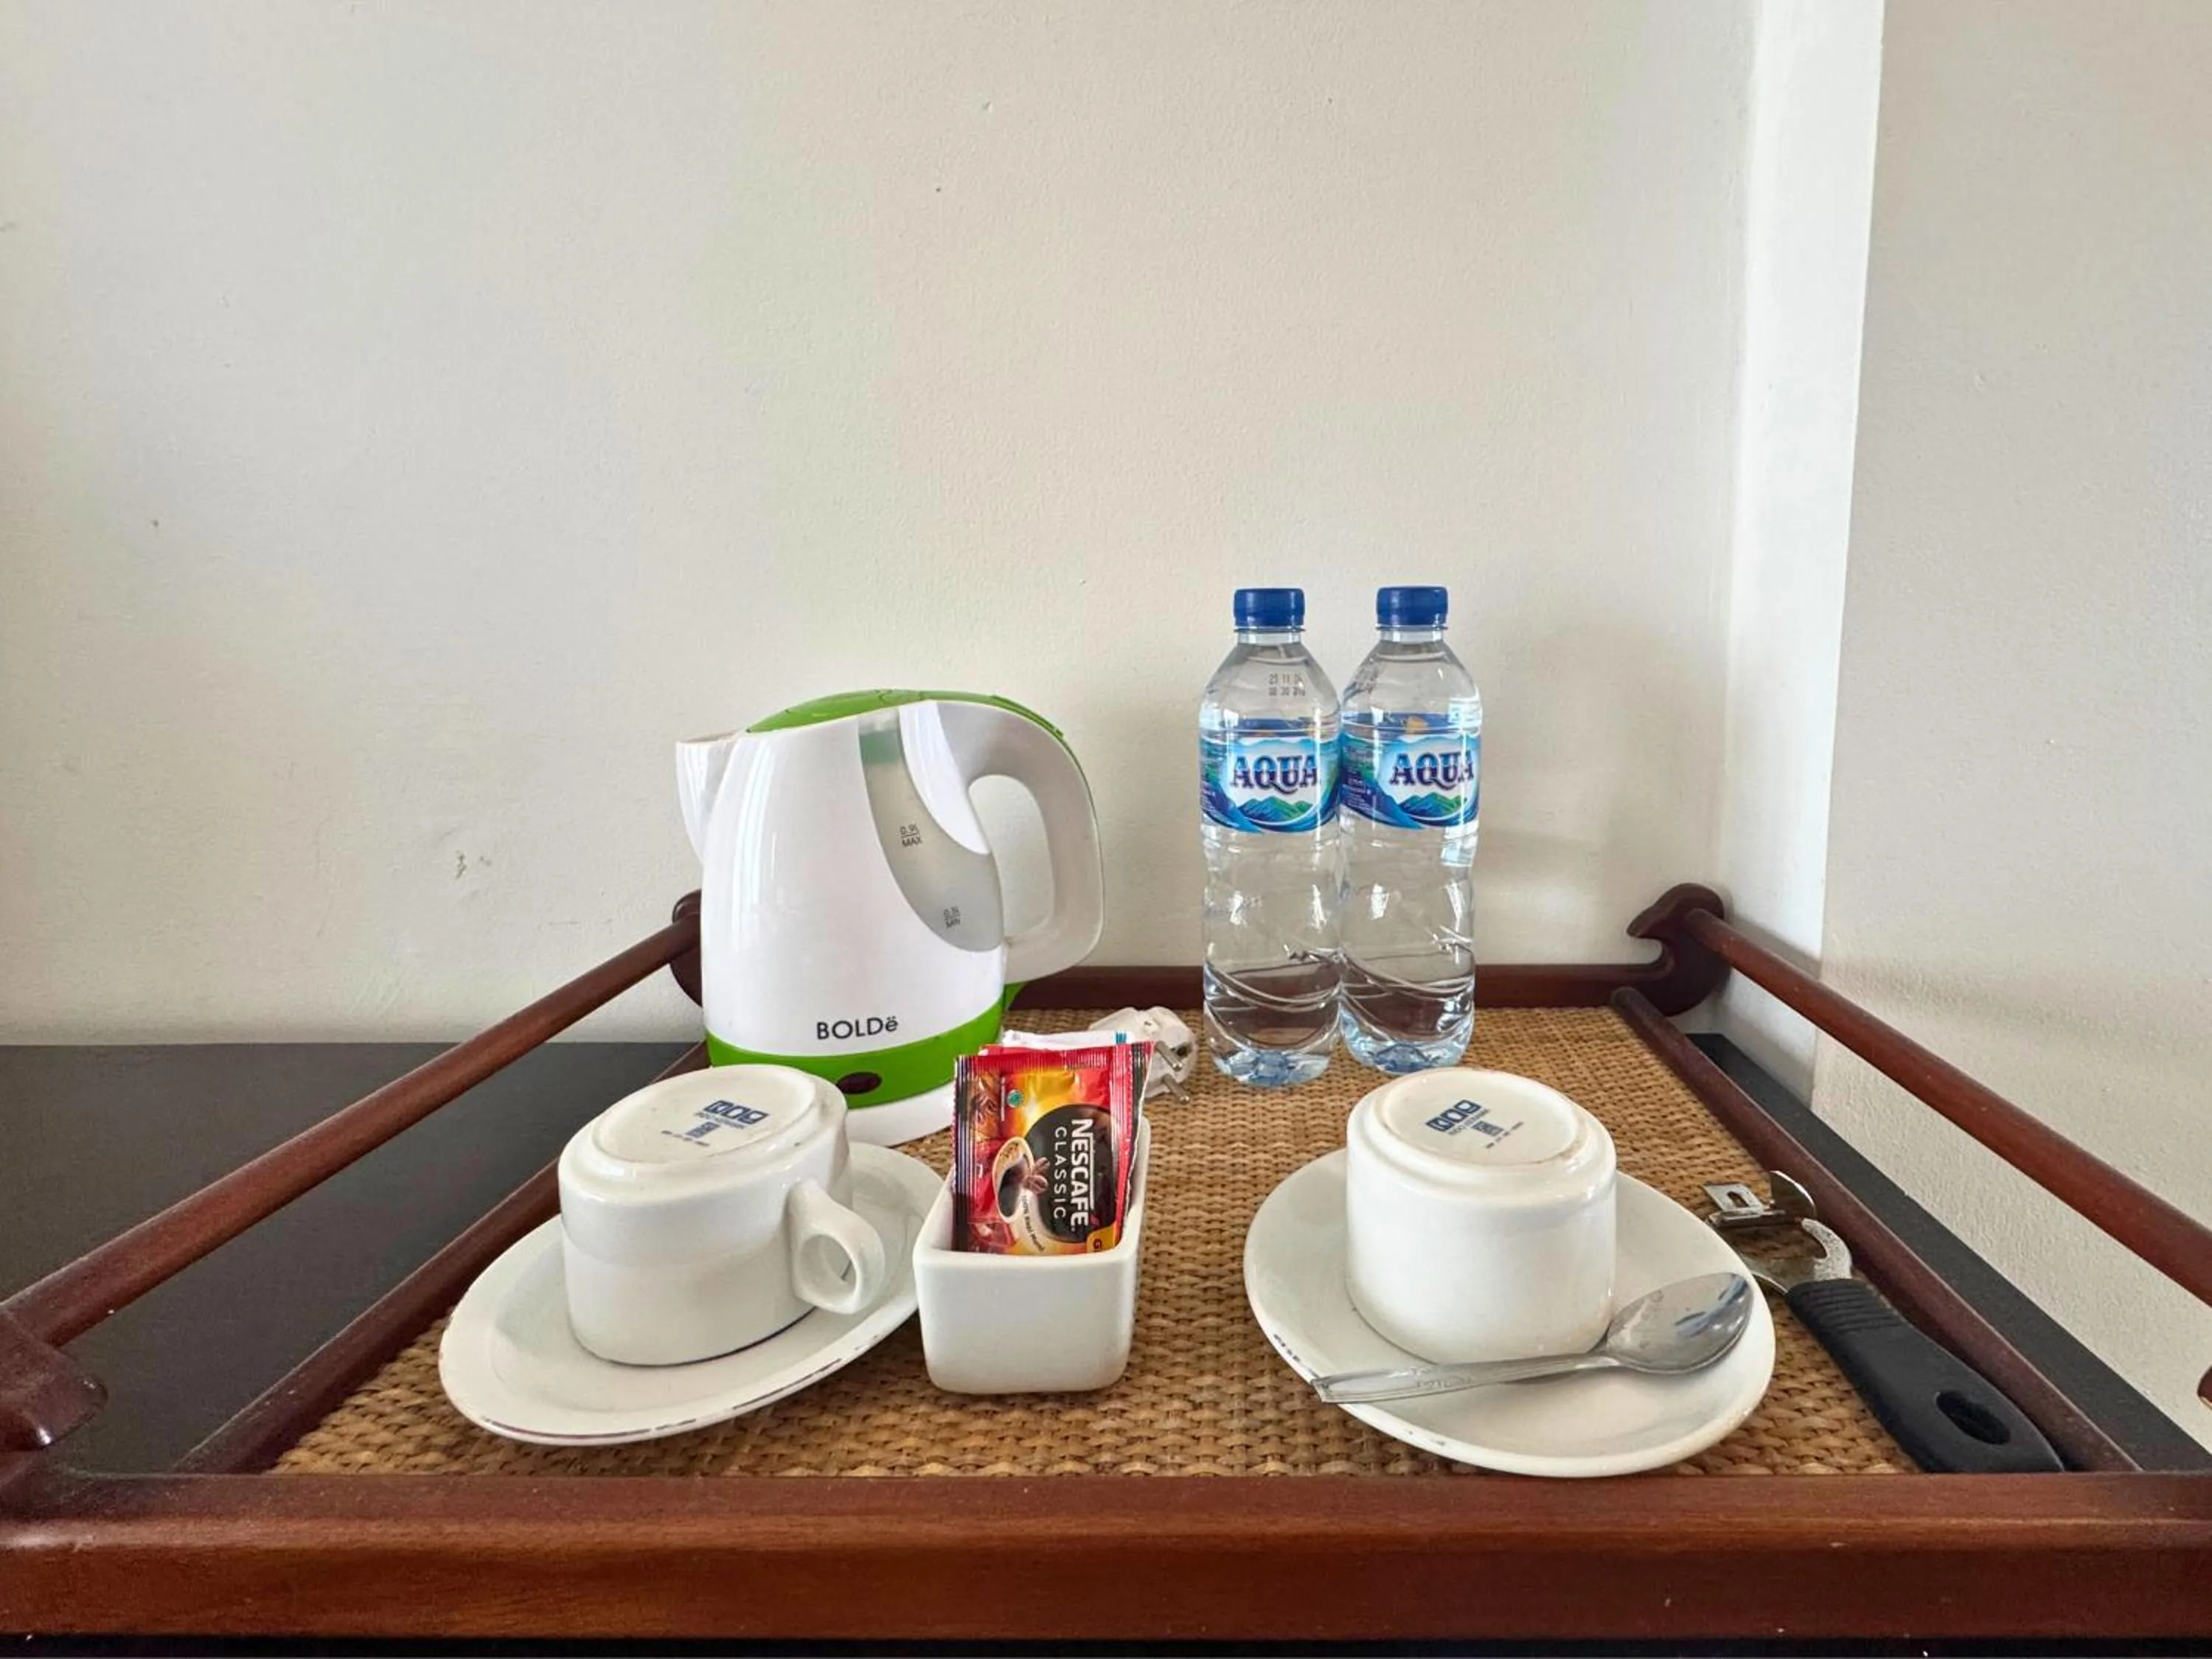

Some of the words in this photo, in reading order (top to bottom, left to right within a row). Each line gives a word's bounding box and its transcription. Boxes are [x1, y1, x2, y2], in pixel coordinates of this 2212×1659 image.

[1231, 754, 1321, 794] AQUA
[1389, 751, 1475, 792] AQUA
[902, 836, 922, 847] MAX
[816, 1015, 899, 1040] BOLDë
[1054, 1127, 1068, 1219] CLASSIC
